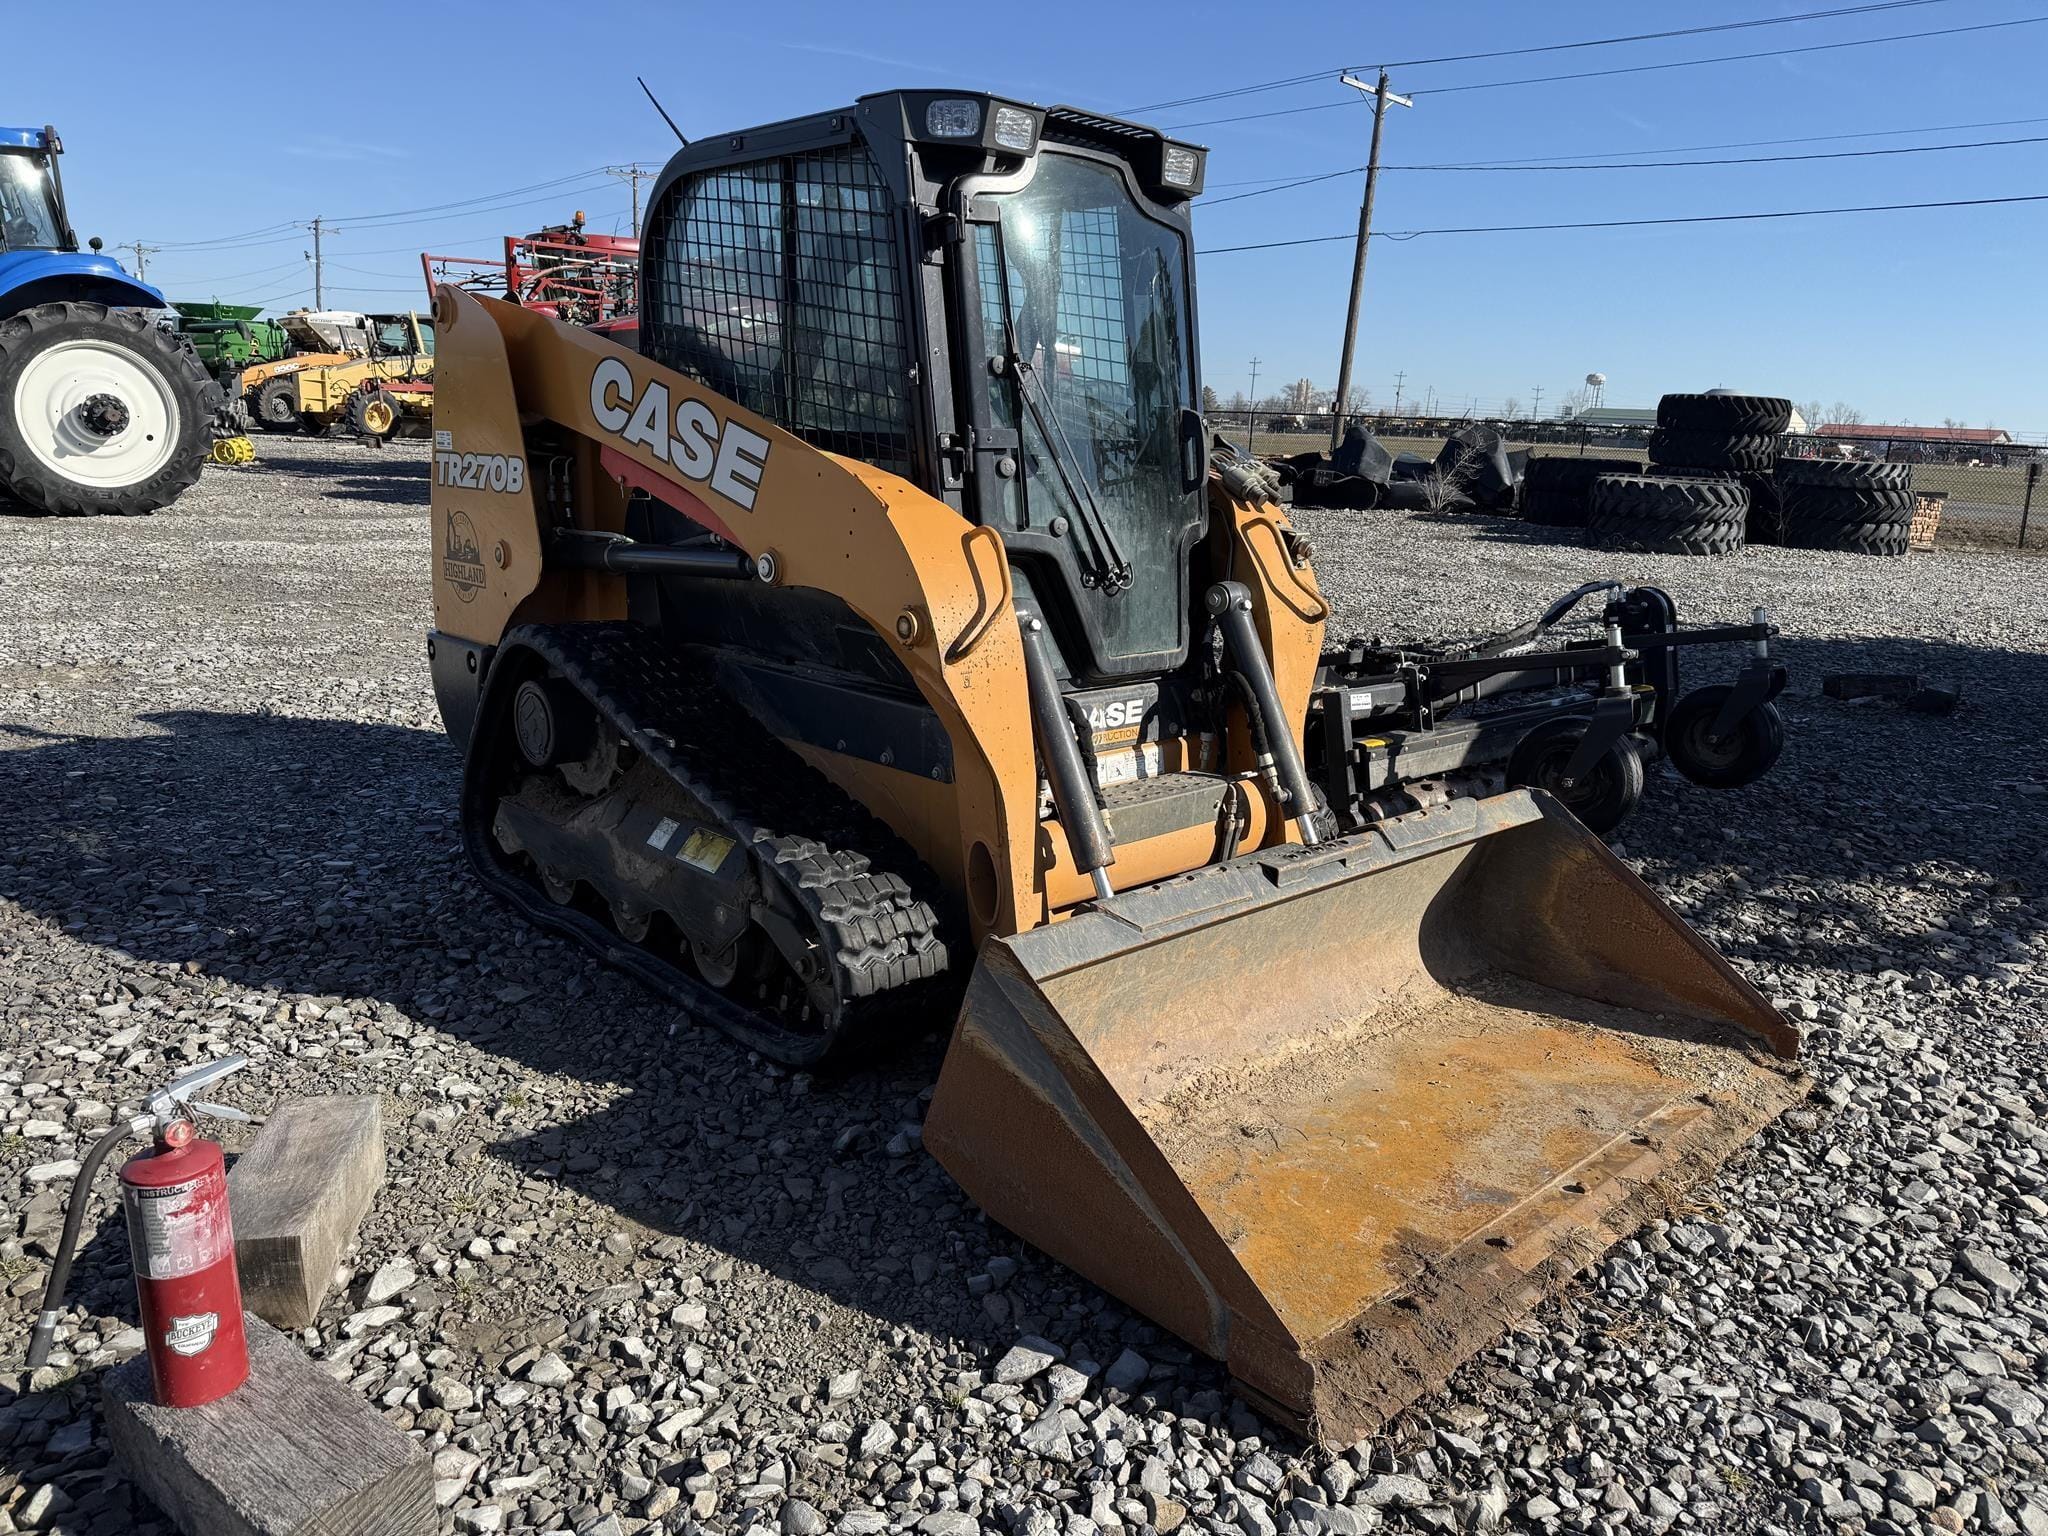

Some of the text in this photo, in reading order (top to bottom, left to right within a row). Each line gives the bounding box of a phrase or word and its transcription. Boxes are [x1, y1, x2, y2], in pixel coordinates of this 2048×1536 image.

[590, 356, 772, 513] CASE
[435, 451, 524, 494] TR270B
[444, 561, 485, 584] HIGHLAND
[1070, 699, 1144, 731] ASE
[170, 1319, 213, 1340] BUCKEYE
